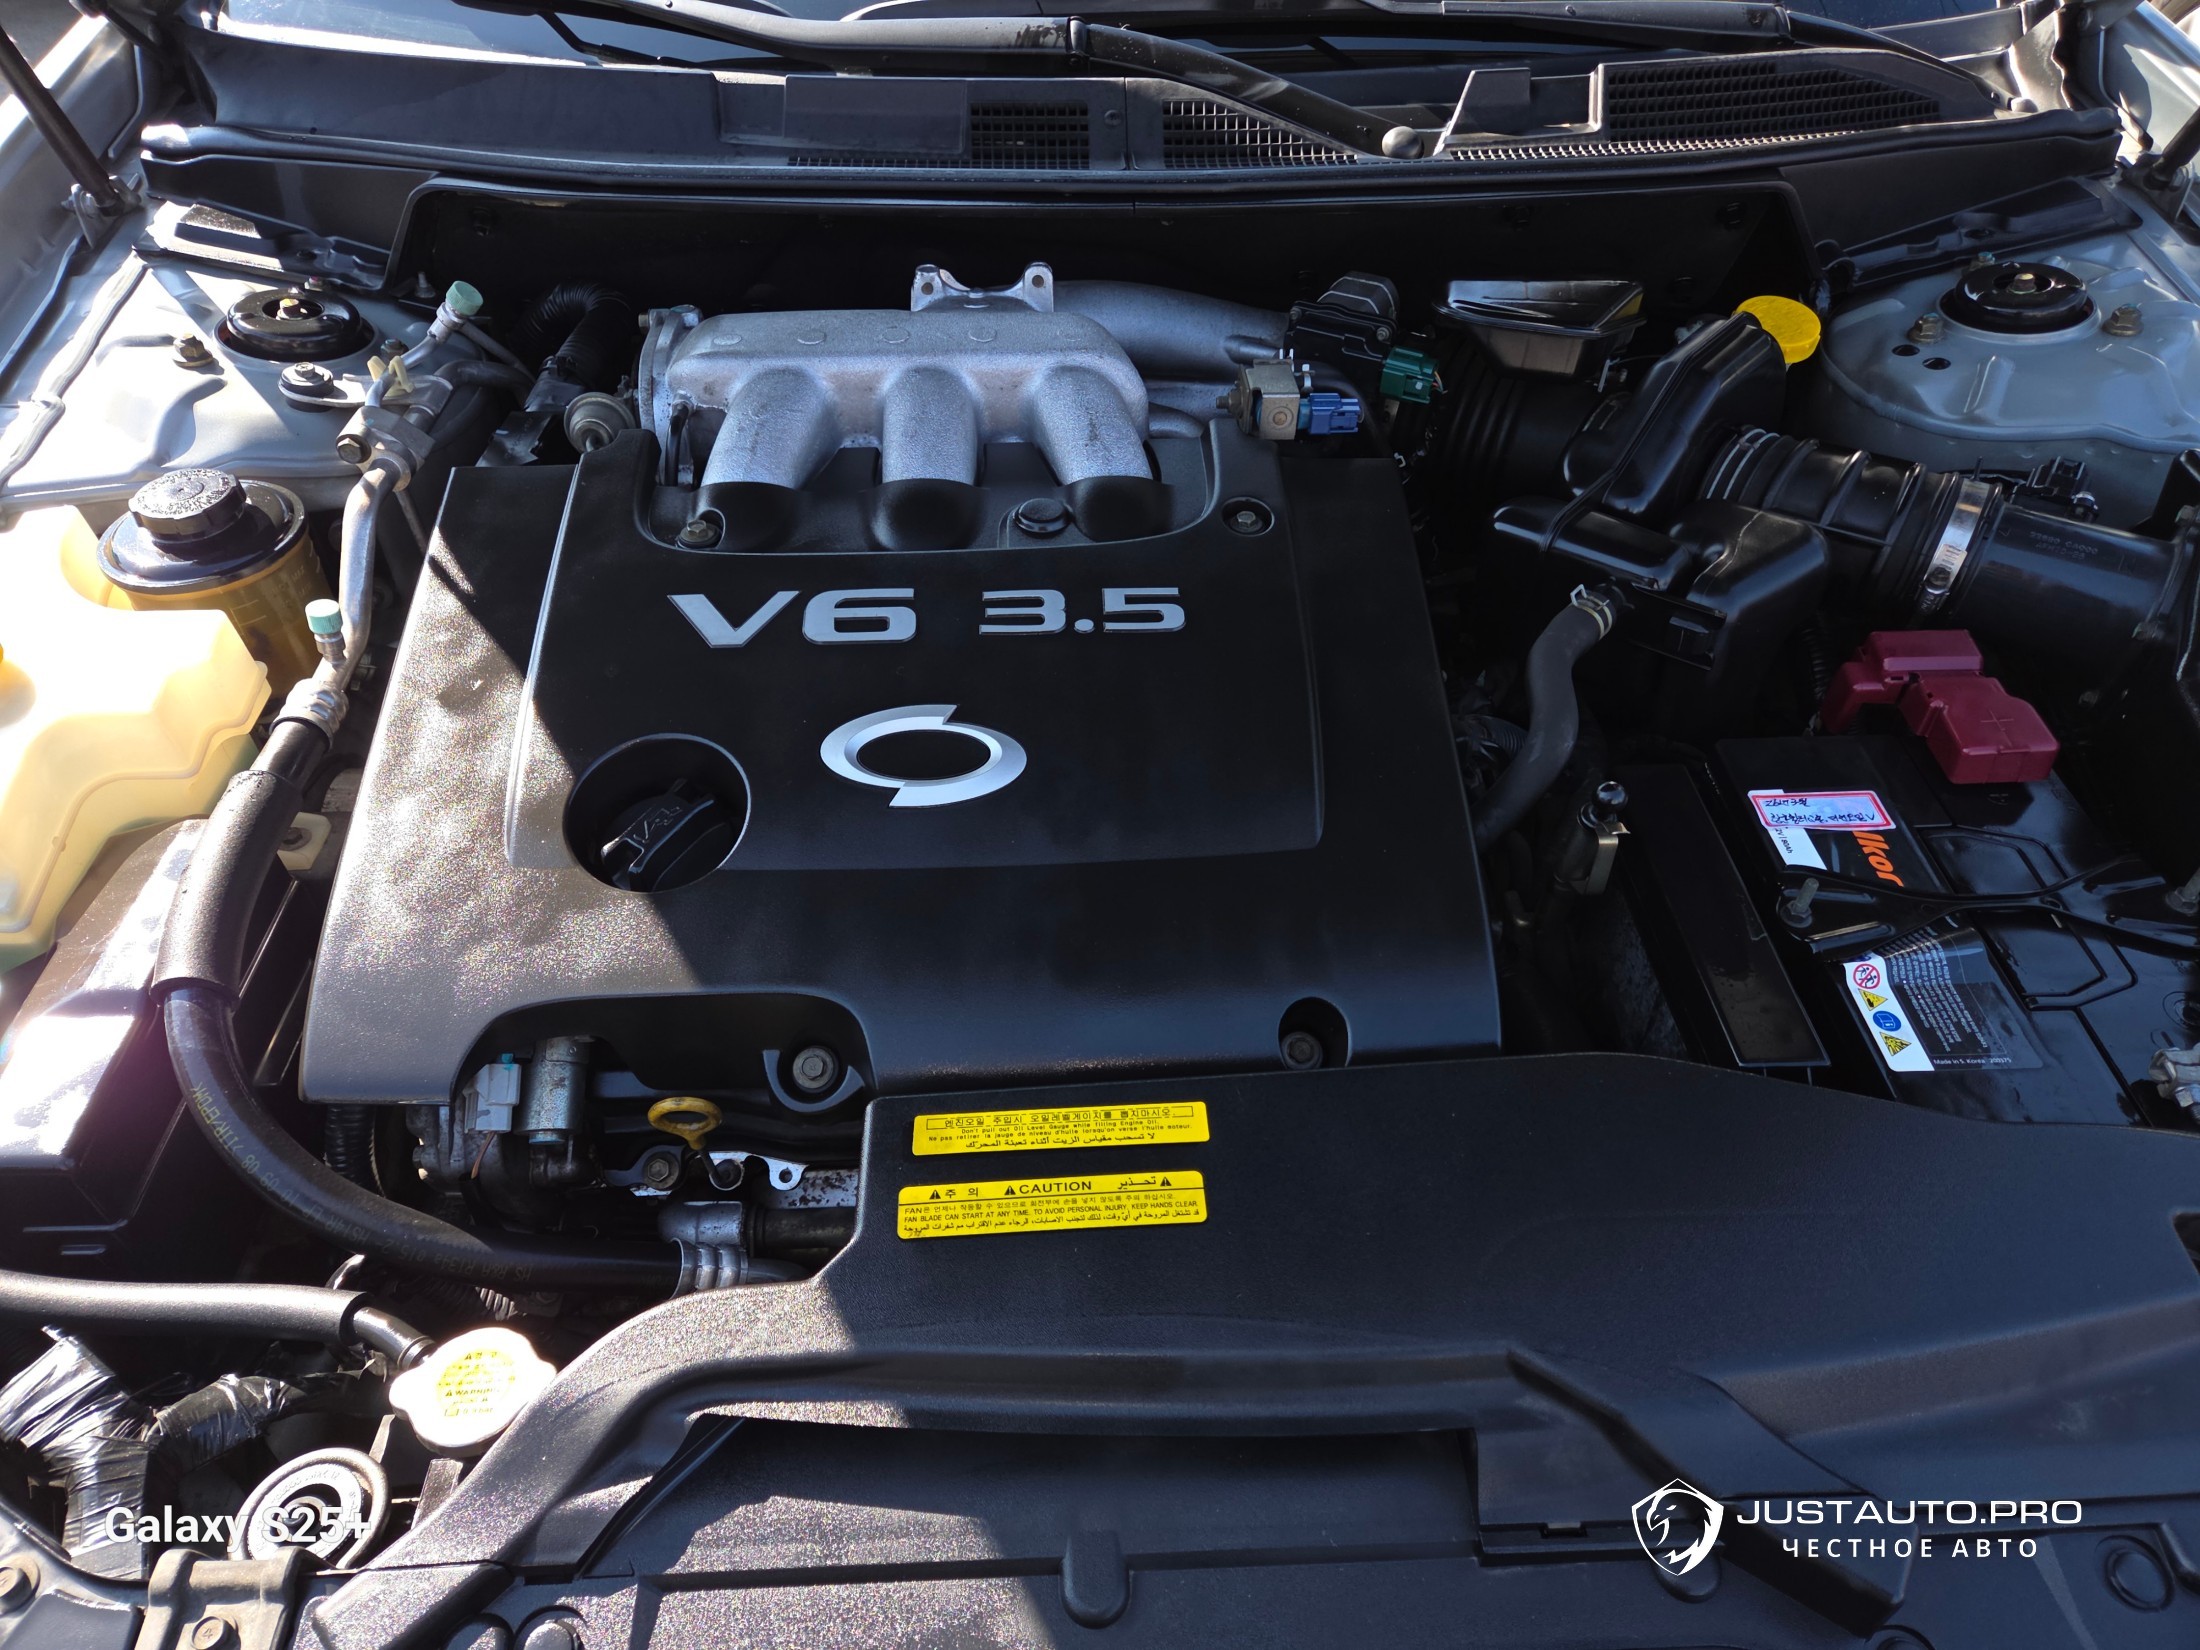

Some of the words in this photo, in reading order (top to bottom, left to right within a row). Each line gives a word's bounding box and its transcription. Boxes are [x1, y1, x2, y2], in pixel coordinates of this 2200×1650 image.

[667, 587, 917, 649] V6
[978, 587, 1188, 635] 3.5
[1852, 830, 1904, 888] lkor
[945, 1117, 984, 1128] 엔진오일
[993, 1115, 1022, 1124] 주입시
[241, 1154, 260, 1174] 08
[1019, 1180, 1092, 1194] CAUTION
[904, 1215, 917, 1223] FAN
[920, 1214, 942, 1222] BLADE
[962, 1212, 983, 1220] START
[1067, 1205, 1101, 1213] PERSONAL
